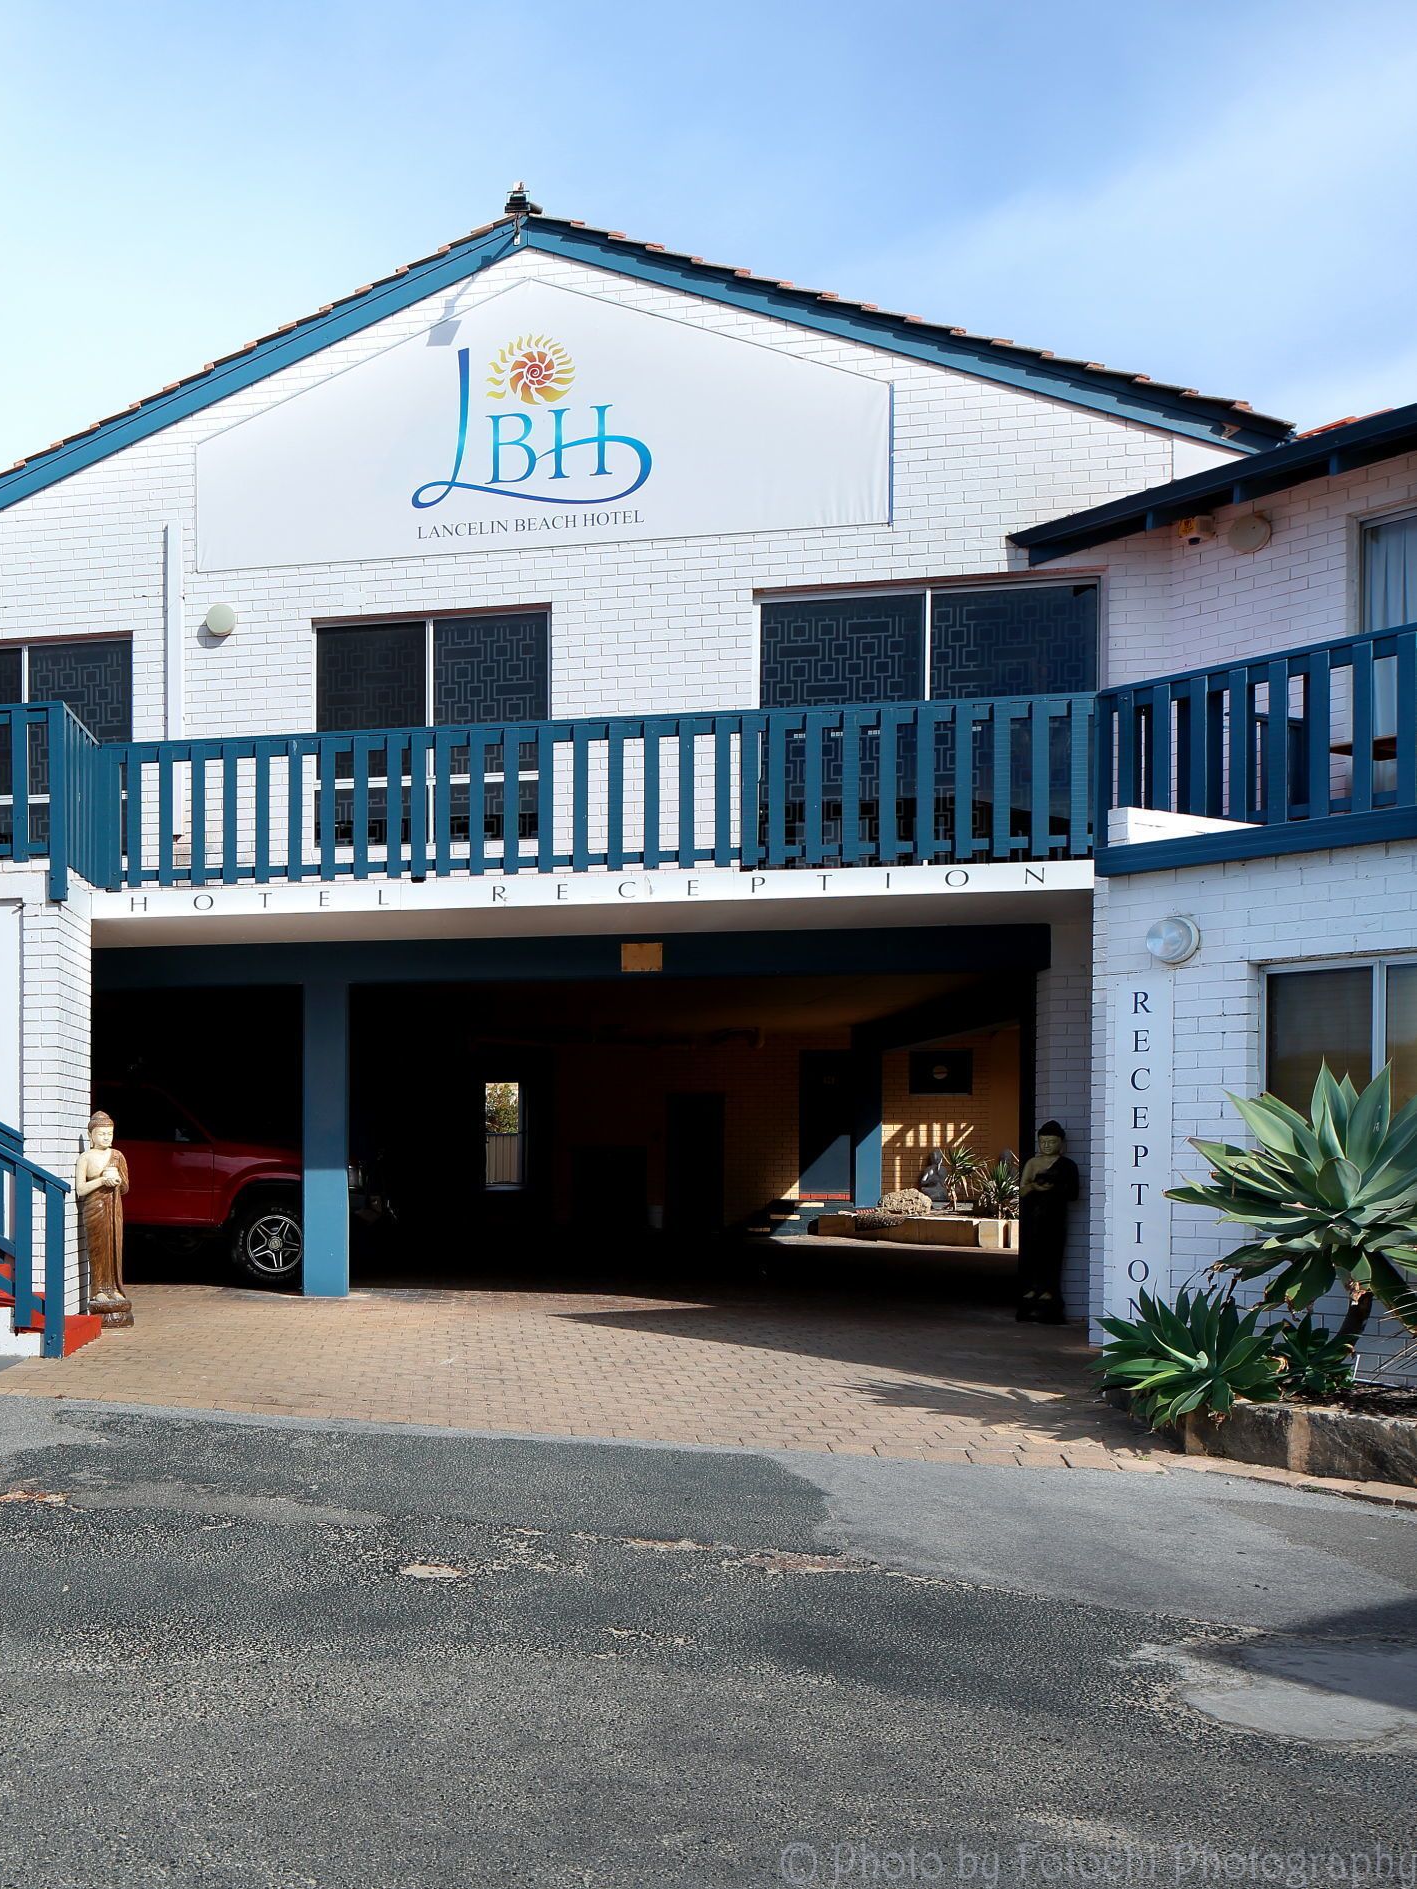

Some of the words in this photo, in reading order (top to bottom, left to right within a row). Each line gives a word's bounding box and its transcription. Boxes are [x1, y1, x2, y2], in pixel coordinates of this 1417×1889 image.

[411, 347, 653, 509] LBH
[417, 518, 509, 540] LANCELIN
[514, 514, 577, 533] BEACH
[582, 509, 645, 528] HOTEL
[130, 889, 390, 913] HOTEL
[492, 866, 1046, 903] RECEPTION
